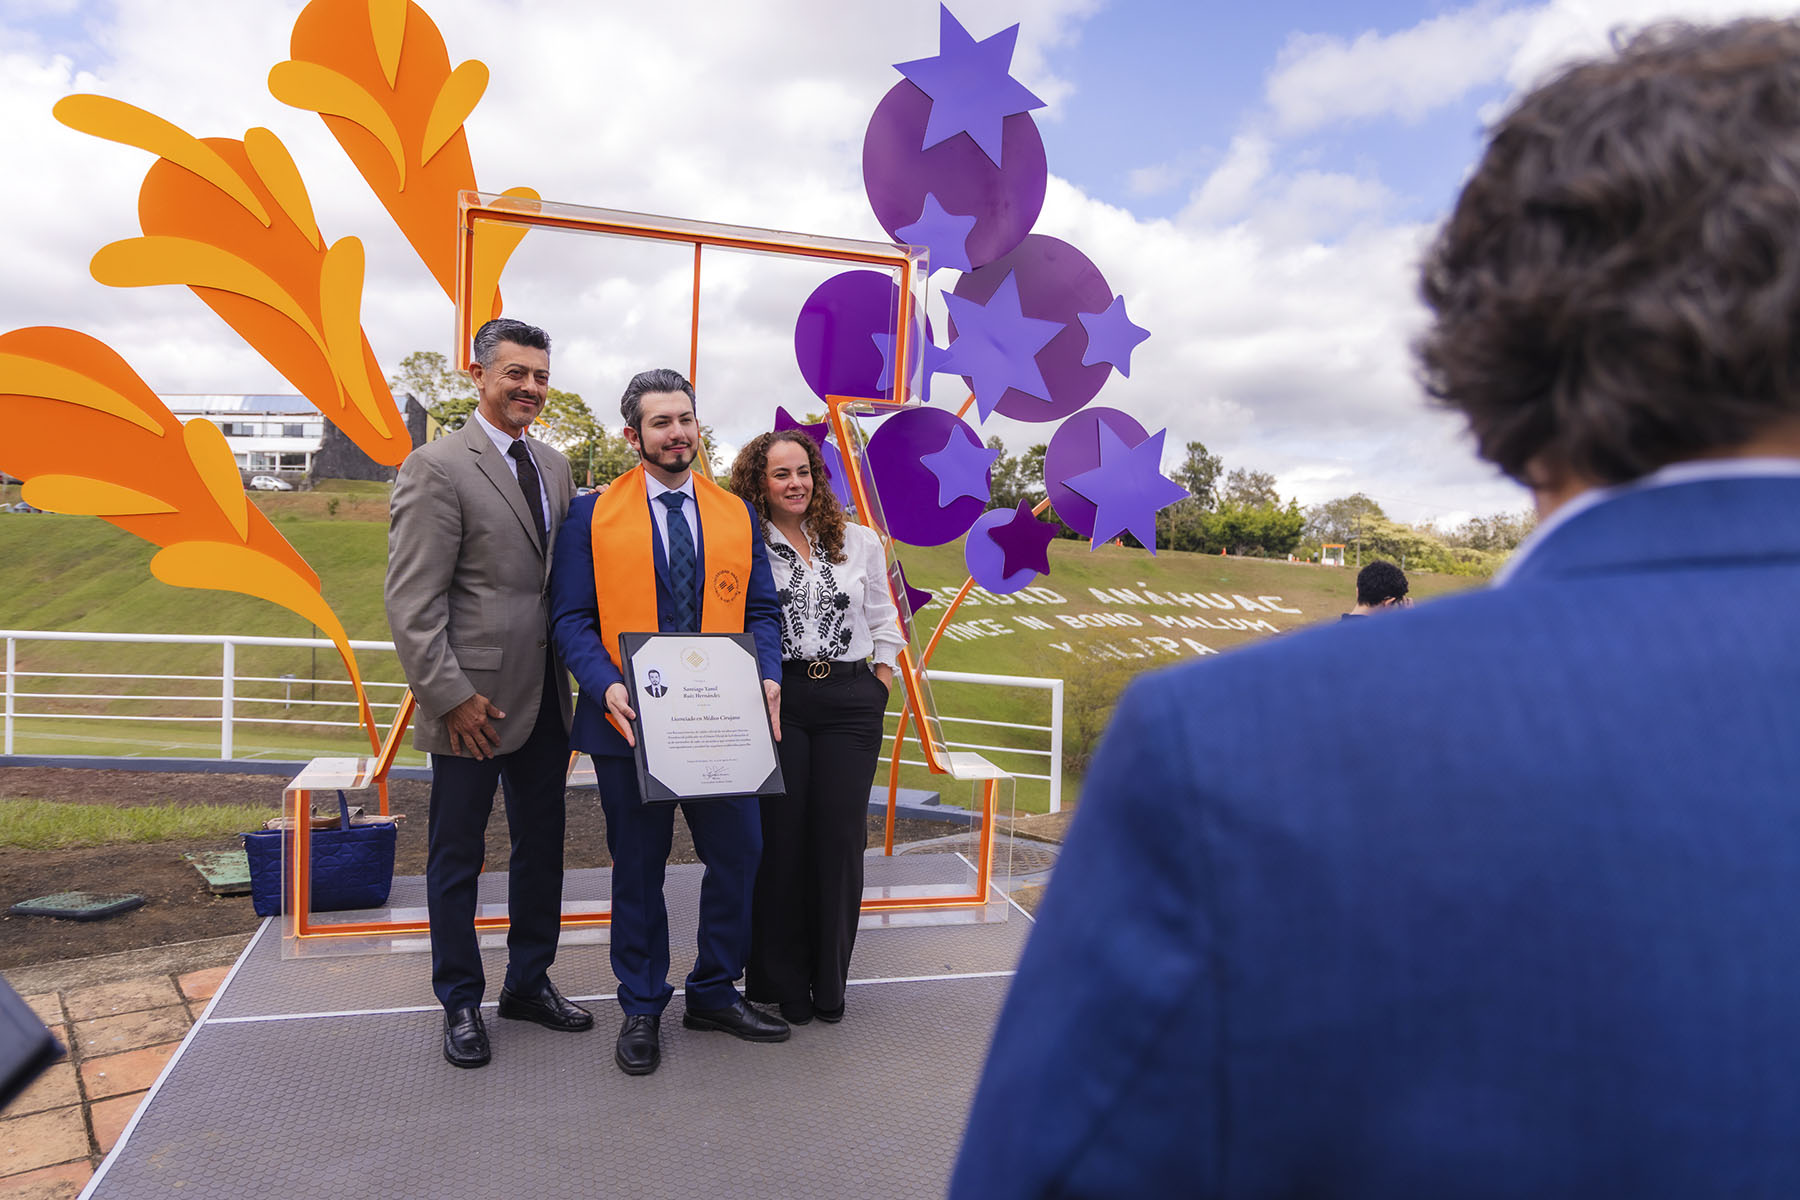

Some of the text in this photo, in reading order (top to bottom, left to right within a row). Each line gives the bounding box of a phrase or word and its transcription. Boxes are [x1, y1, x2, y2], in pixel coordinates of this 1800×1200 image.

[1088, 582, 1303, 614] ANÁHUAC
[1011, 615, 1056, 631] IN
[1055, 613, 1143, 629] BONO
[1150, 614, 1281, 634] MALUM
